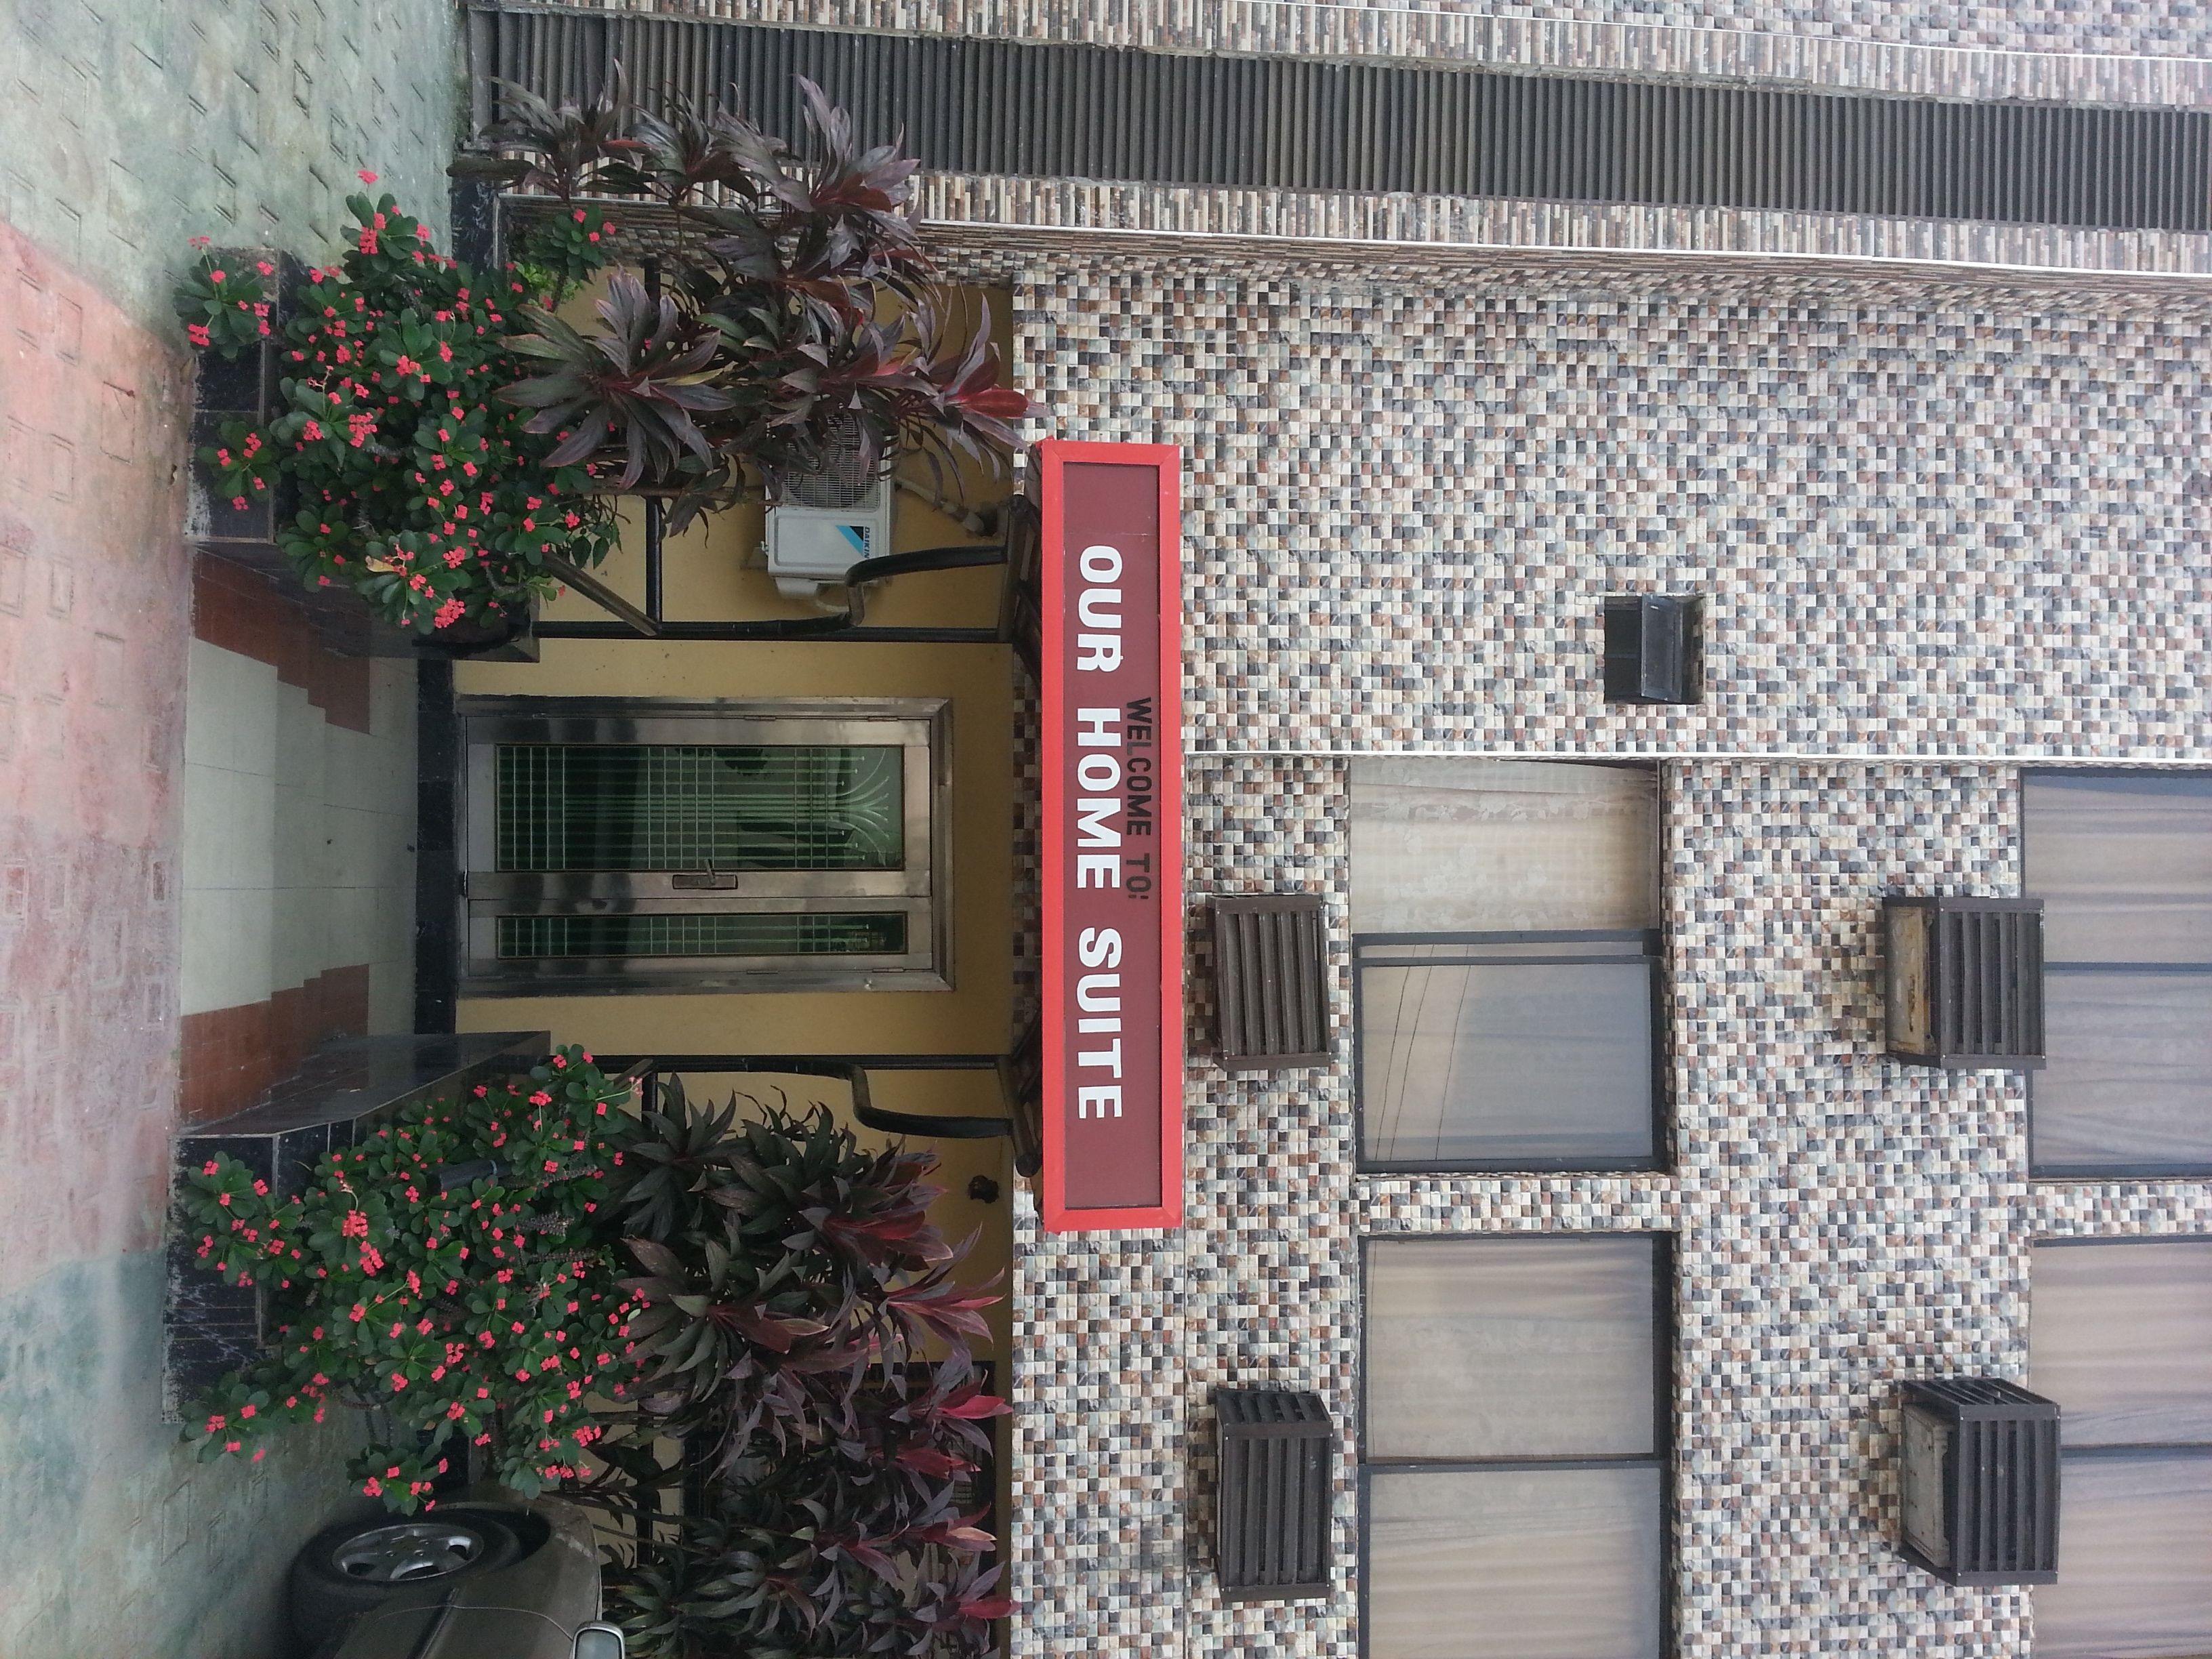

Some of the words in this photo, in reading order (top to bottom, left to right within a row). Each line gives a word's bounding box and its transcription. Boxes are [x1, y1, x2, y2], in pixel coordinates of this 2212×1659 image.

[1076, 544, 1124, 673] OUR
[1076, 707, 1122, 889] HOME
[1126, 697, 1153, 836] WELCOME
[1125, 852, 1152, 900] TO:
[1076, 926, 1123, 1120] SUITE
